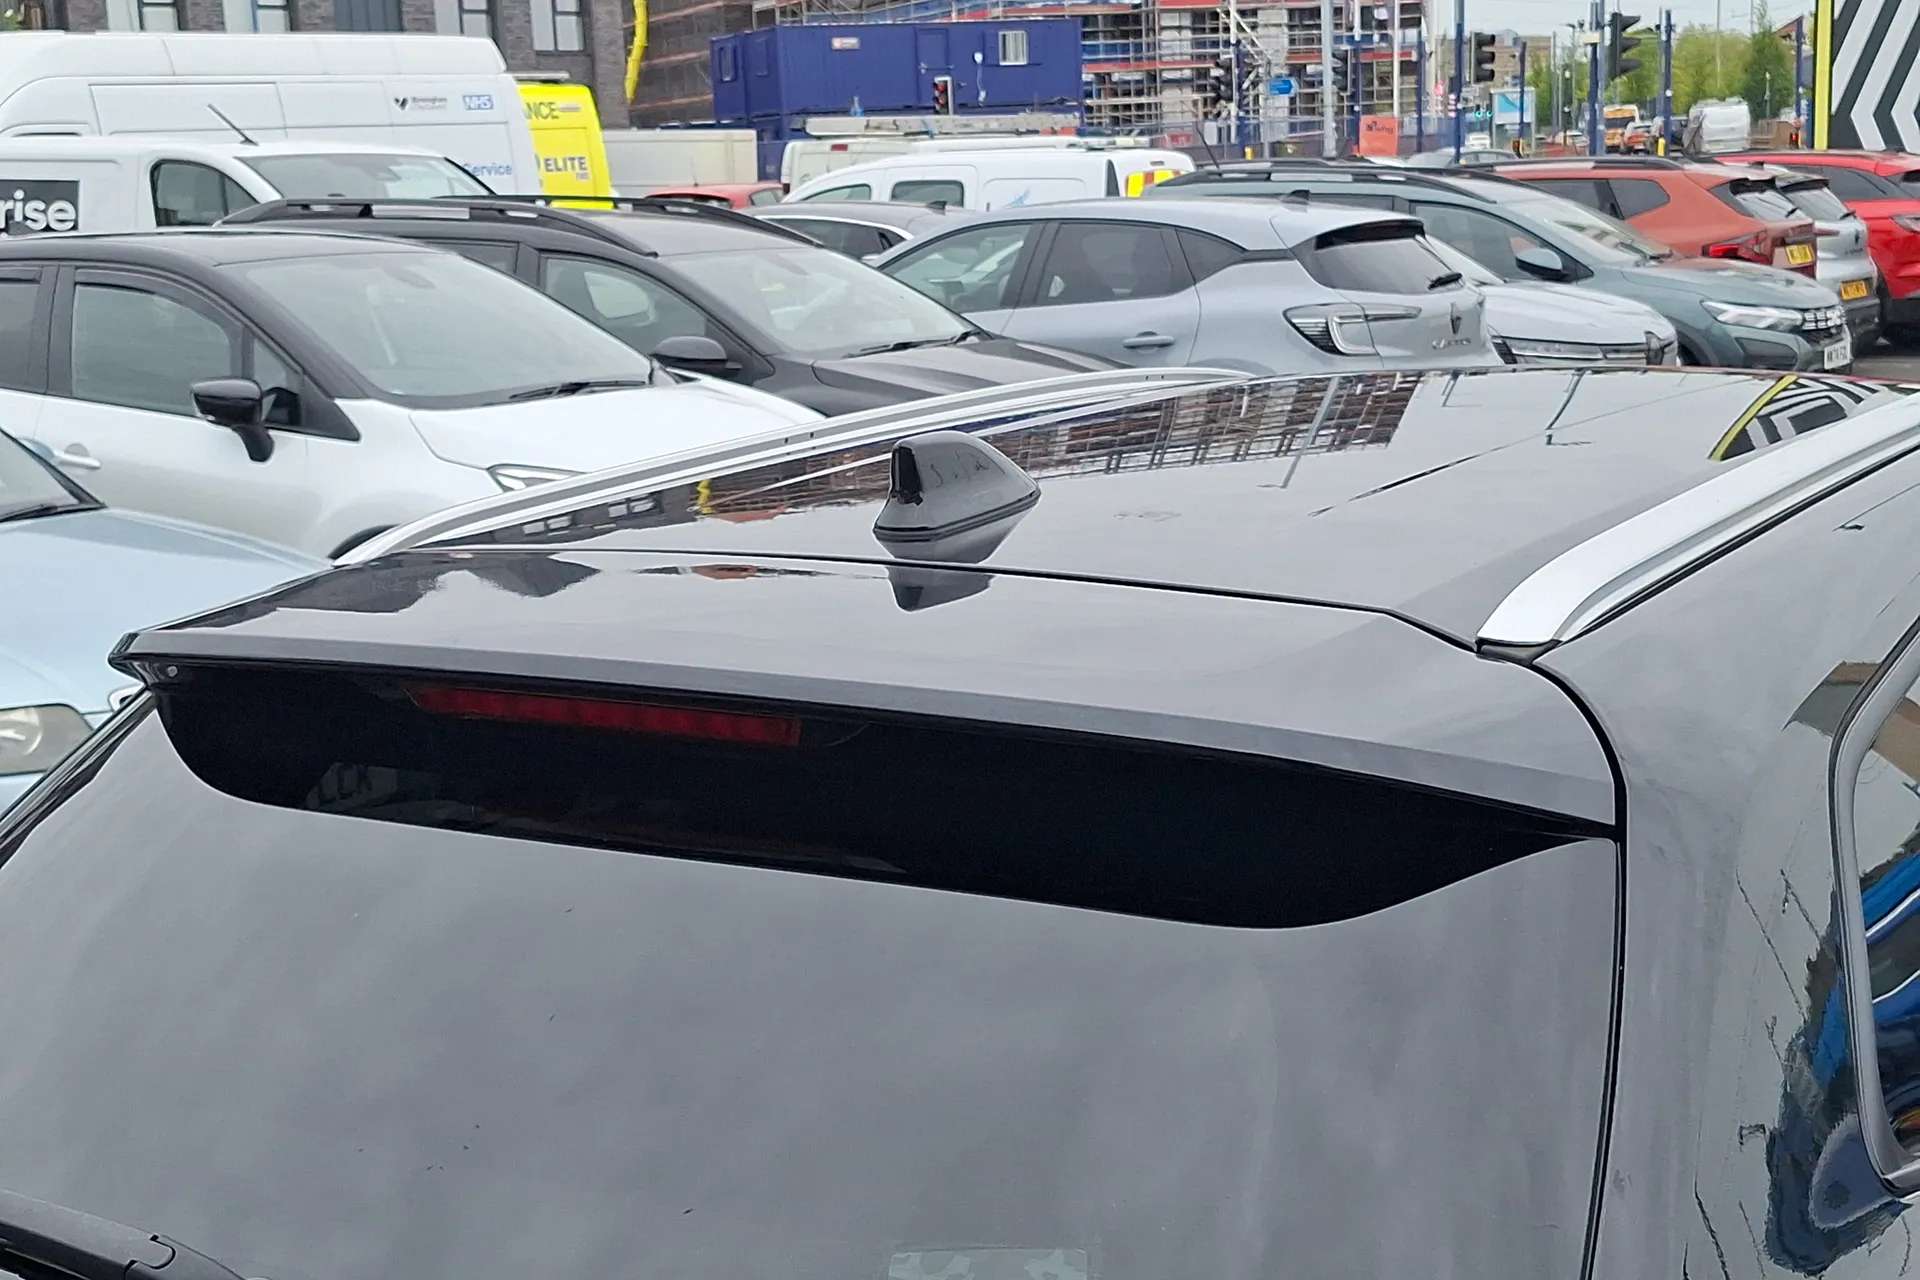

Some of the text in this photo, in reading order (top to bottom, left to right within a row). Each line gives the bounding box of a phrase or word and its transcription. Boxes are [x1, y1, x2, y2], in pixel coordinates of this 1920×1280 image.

[464, 95, 493, 110] NHS
[544, 156, 588, 172] ELITE
[0, 189, 76, 231] rise
